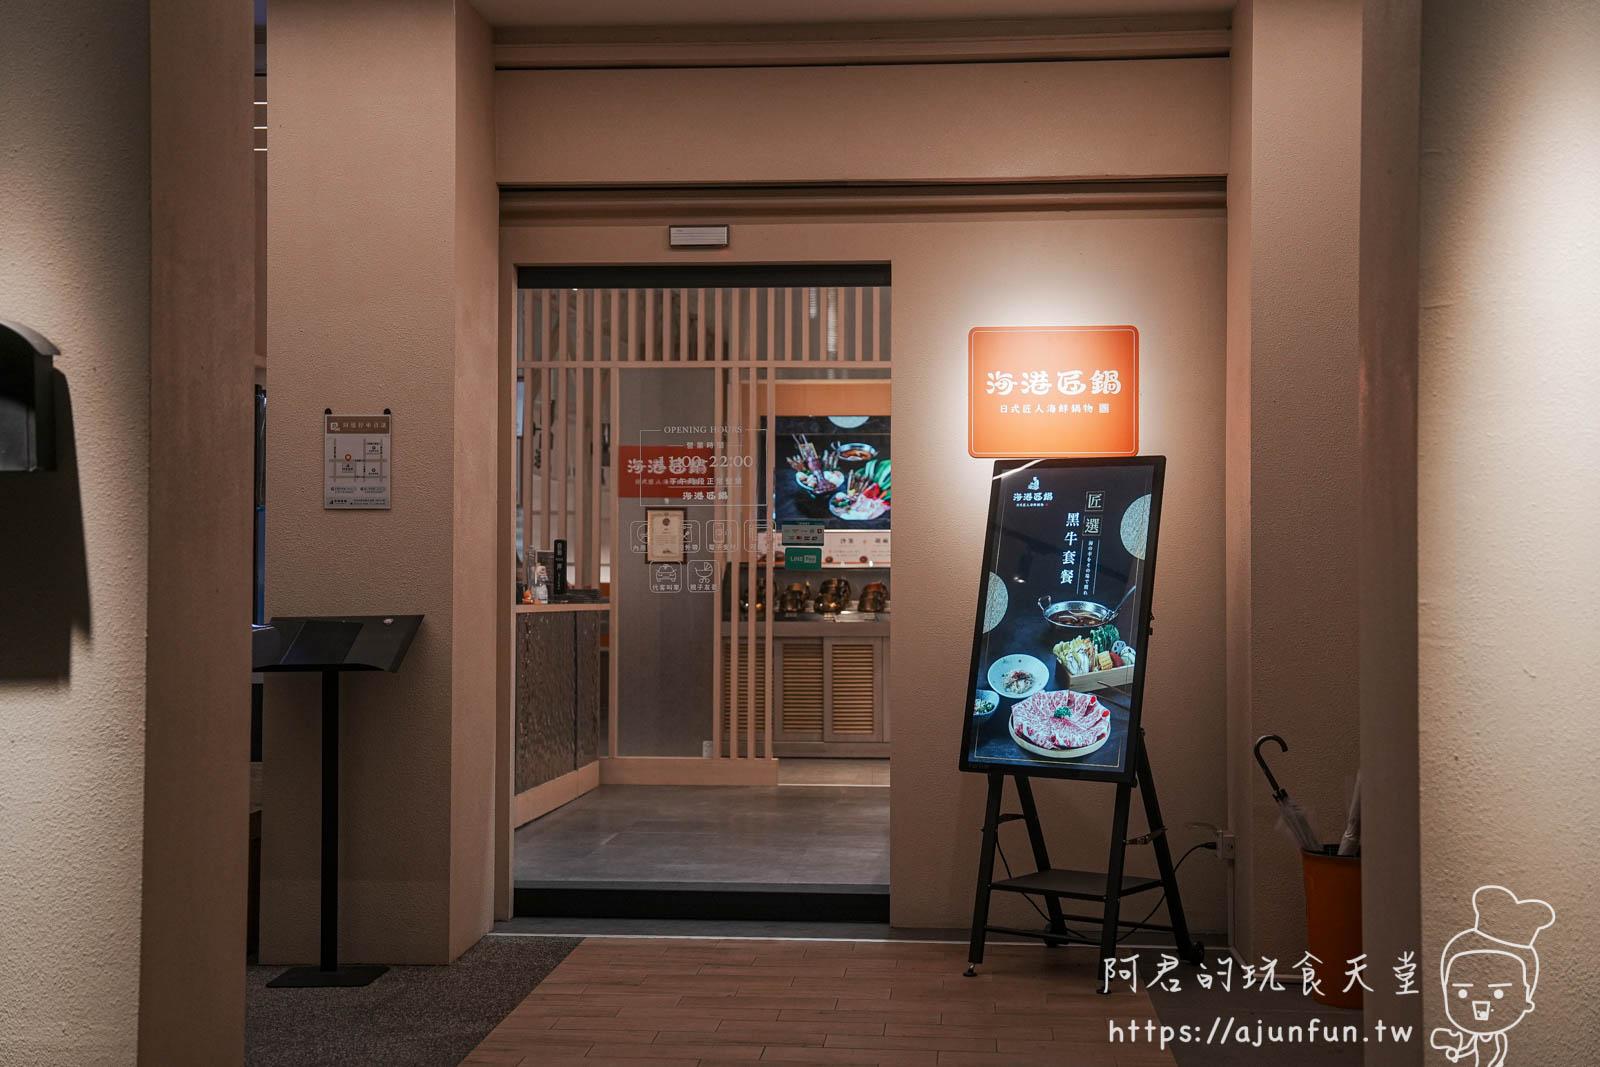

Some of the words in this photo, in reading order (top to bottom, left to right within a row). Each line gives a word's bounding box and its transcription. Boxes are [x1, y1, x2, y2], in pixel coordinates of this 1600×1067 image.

[986, 370, 1122, 396] 海港匠鍋
[664, 426, 707, 434] OPENING
[710, 426, 742, 434] HOURS
[682, 491, 729, 501] 海港匠鍋
[1013, 491, 1054, 502] 海港匠鍋
[1060, 512, 1080, 585] 黑牛套餐
